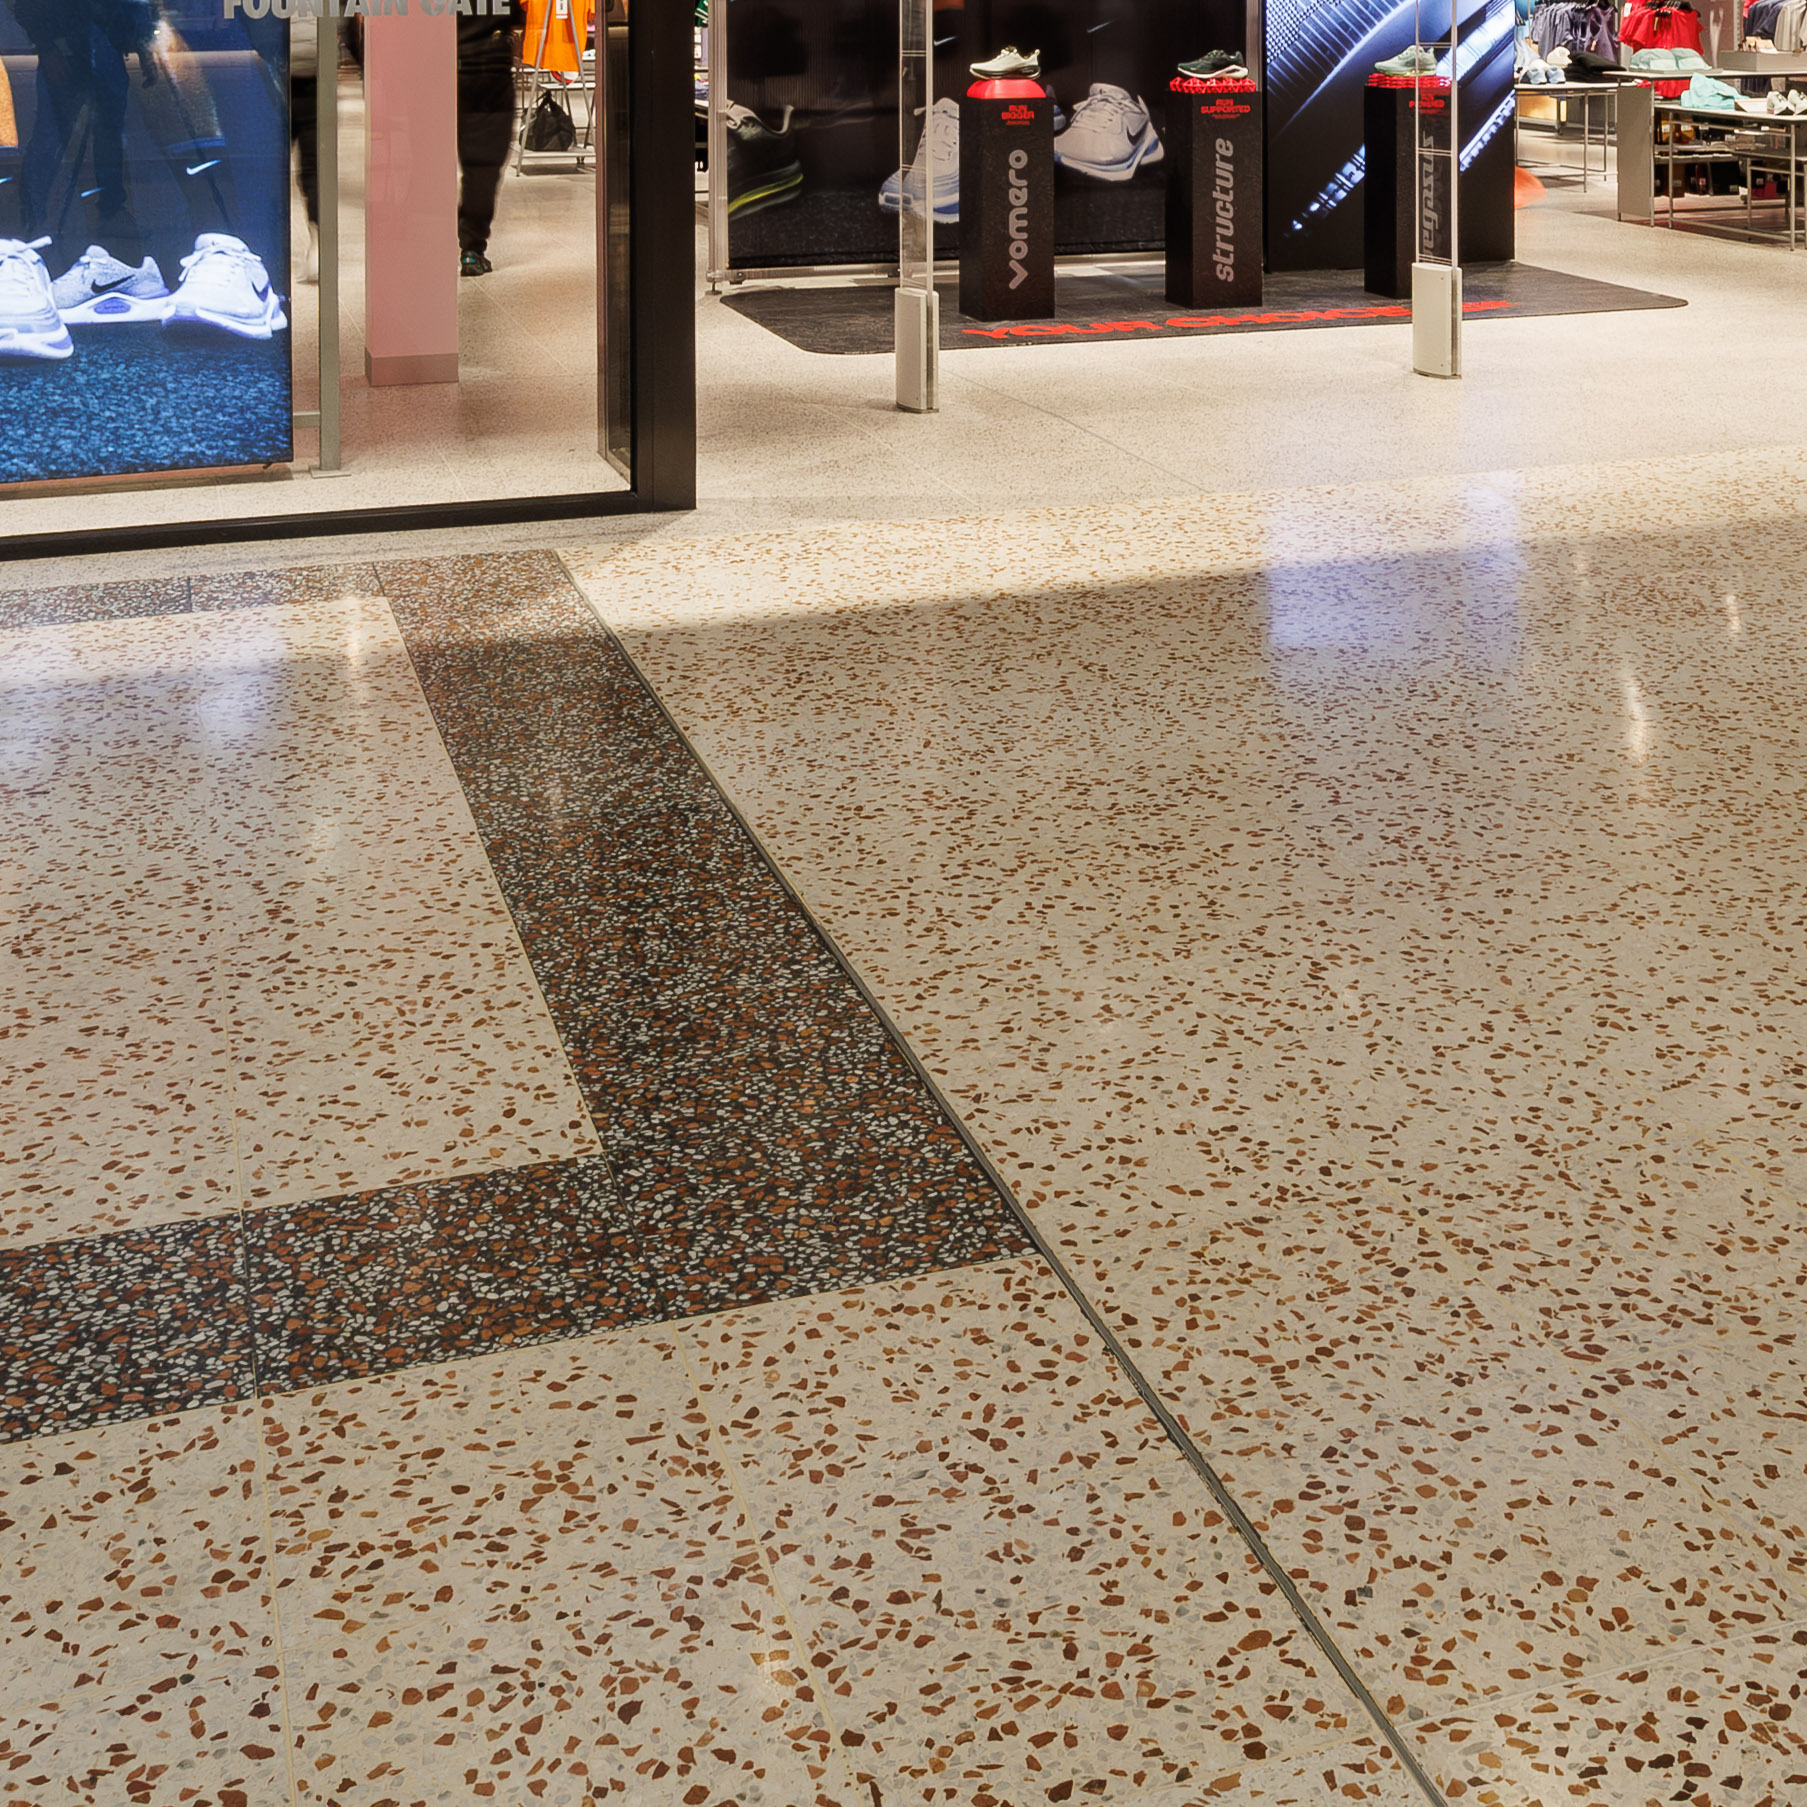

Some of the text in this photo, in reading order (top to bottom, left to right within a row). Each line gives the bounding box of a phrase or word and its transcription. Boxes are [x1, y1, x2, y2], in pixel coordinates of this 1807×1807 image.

[1008, 149, 1029, 290] vomero
[1212, 137, 1235, 283] structure
[962, 320, 1163, 340] YOUR
